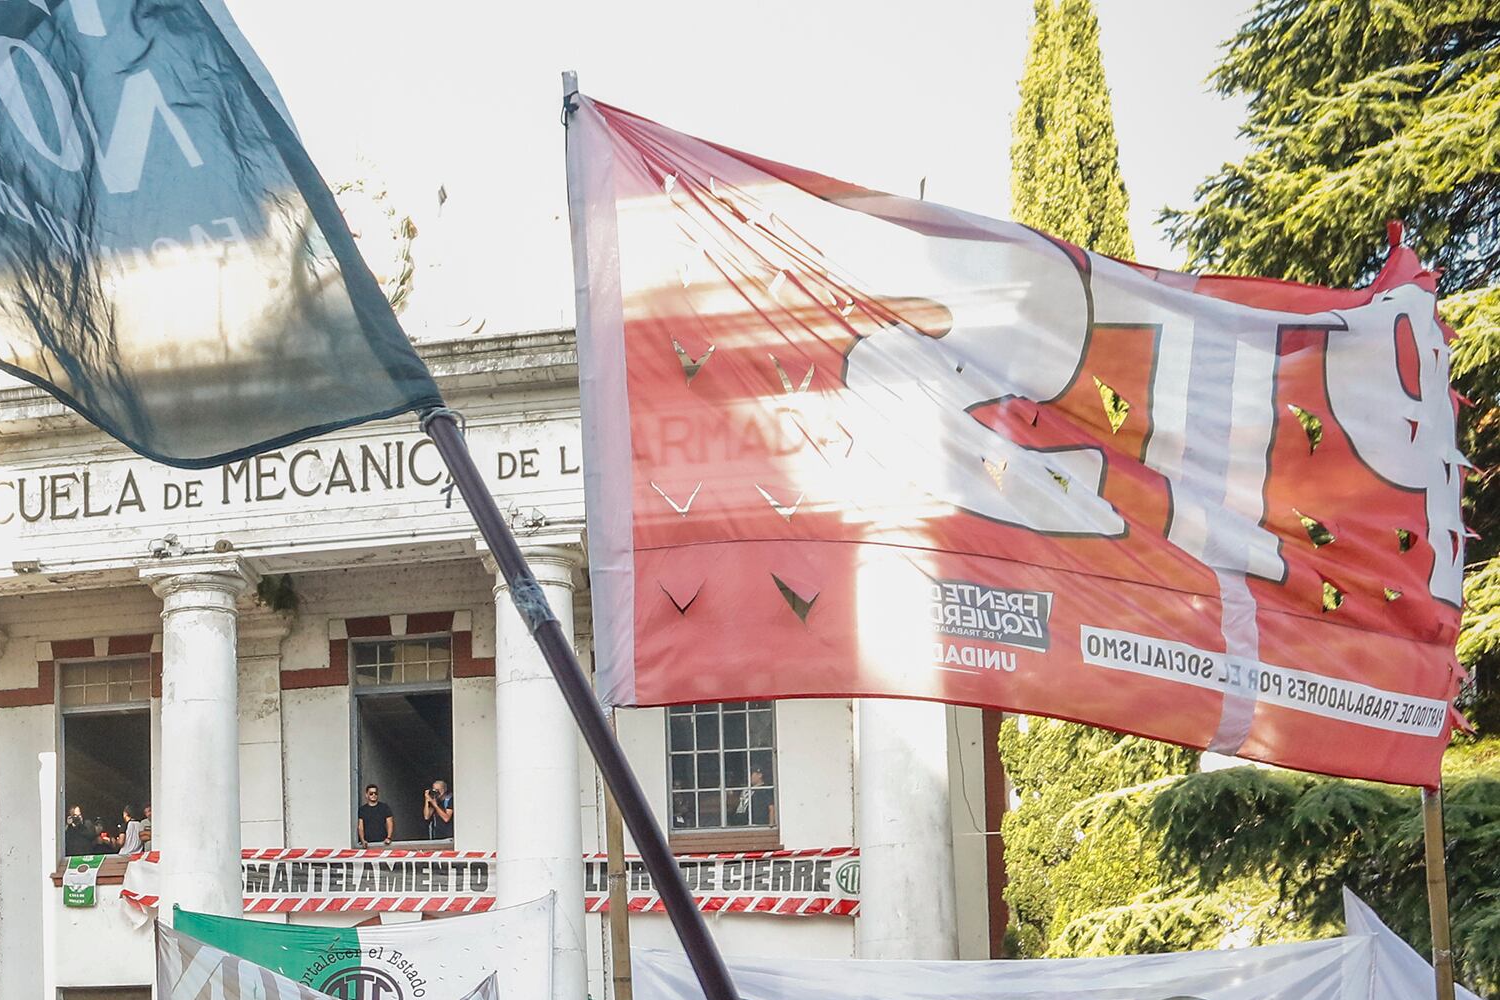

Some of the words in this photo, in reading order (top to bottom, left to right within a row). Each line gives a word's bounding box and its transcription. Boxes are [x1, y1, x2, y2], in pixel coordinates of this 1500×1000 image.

[163, 480, 204, 511] DE
[221, 439, 453, 504] MECANIC
[497, 447, 540, 481] DE
[630, 405, 810, 467] ARMAD
[241, 861, 489, 893] MANTELAMIENTO
[722, 859, 832, 892] CIERRE
[300, 946, 363, 987] ortalecer
[368, 946, 383, 959] el
[386, 950, 427, 998] Estado
